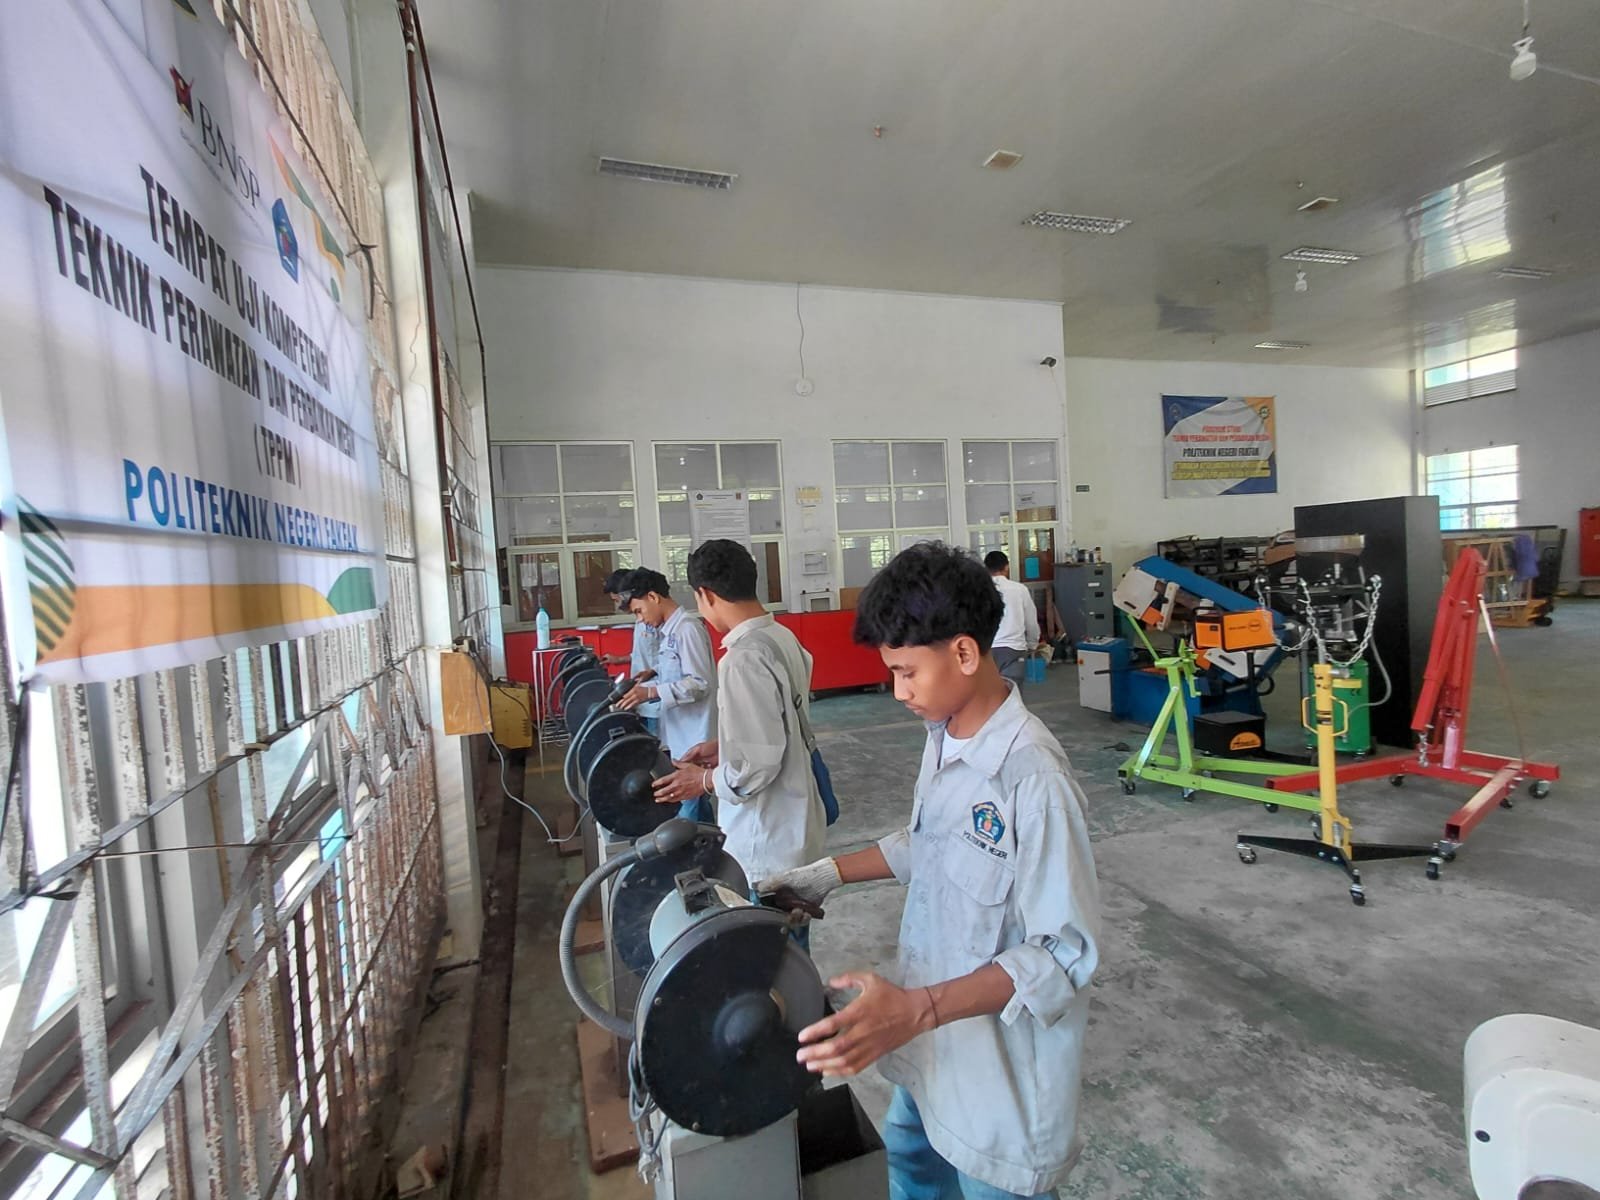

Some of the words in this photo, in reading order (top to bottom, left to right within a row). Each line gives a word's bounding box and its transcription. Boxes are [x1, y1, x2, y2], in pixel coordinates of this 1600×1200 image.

[198, 98, 260, 209] BNSP
[43, 184, 157, 335] TEKNIK
[159, 274, 260, 401] PERAWATAN
[264, 358, 289, 419] DAN
[139, 163, 230, 305] TEMPAT
[231, 259, 261, 334] UJI
[122, 458, 273, 542] POLITEKNIK
[274, 502, 323, 549] NEGERI
[323, 516, 359, 553] FAKFAK
